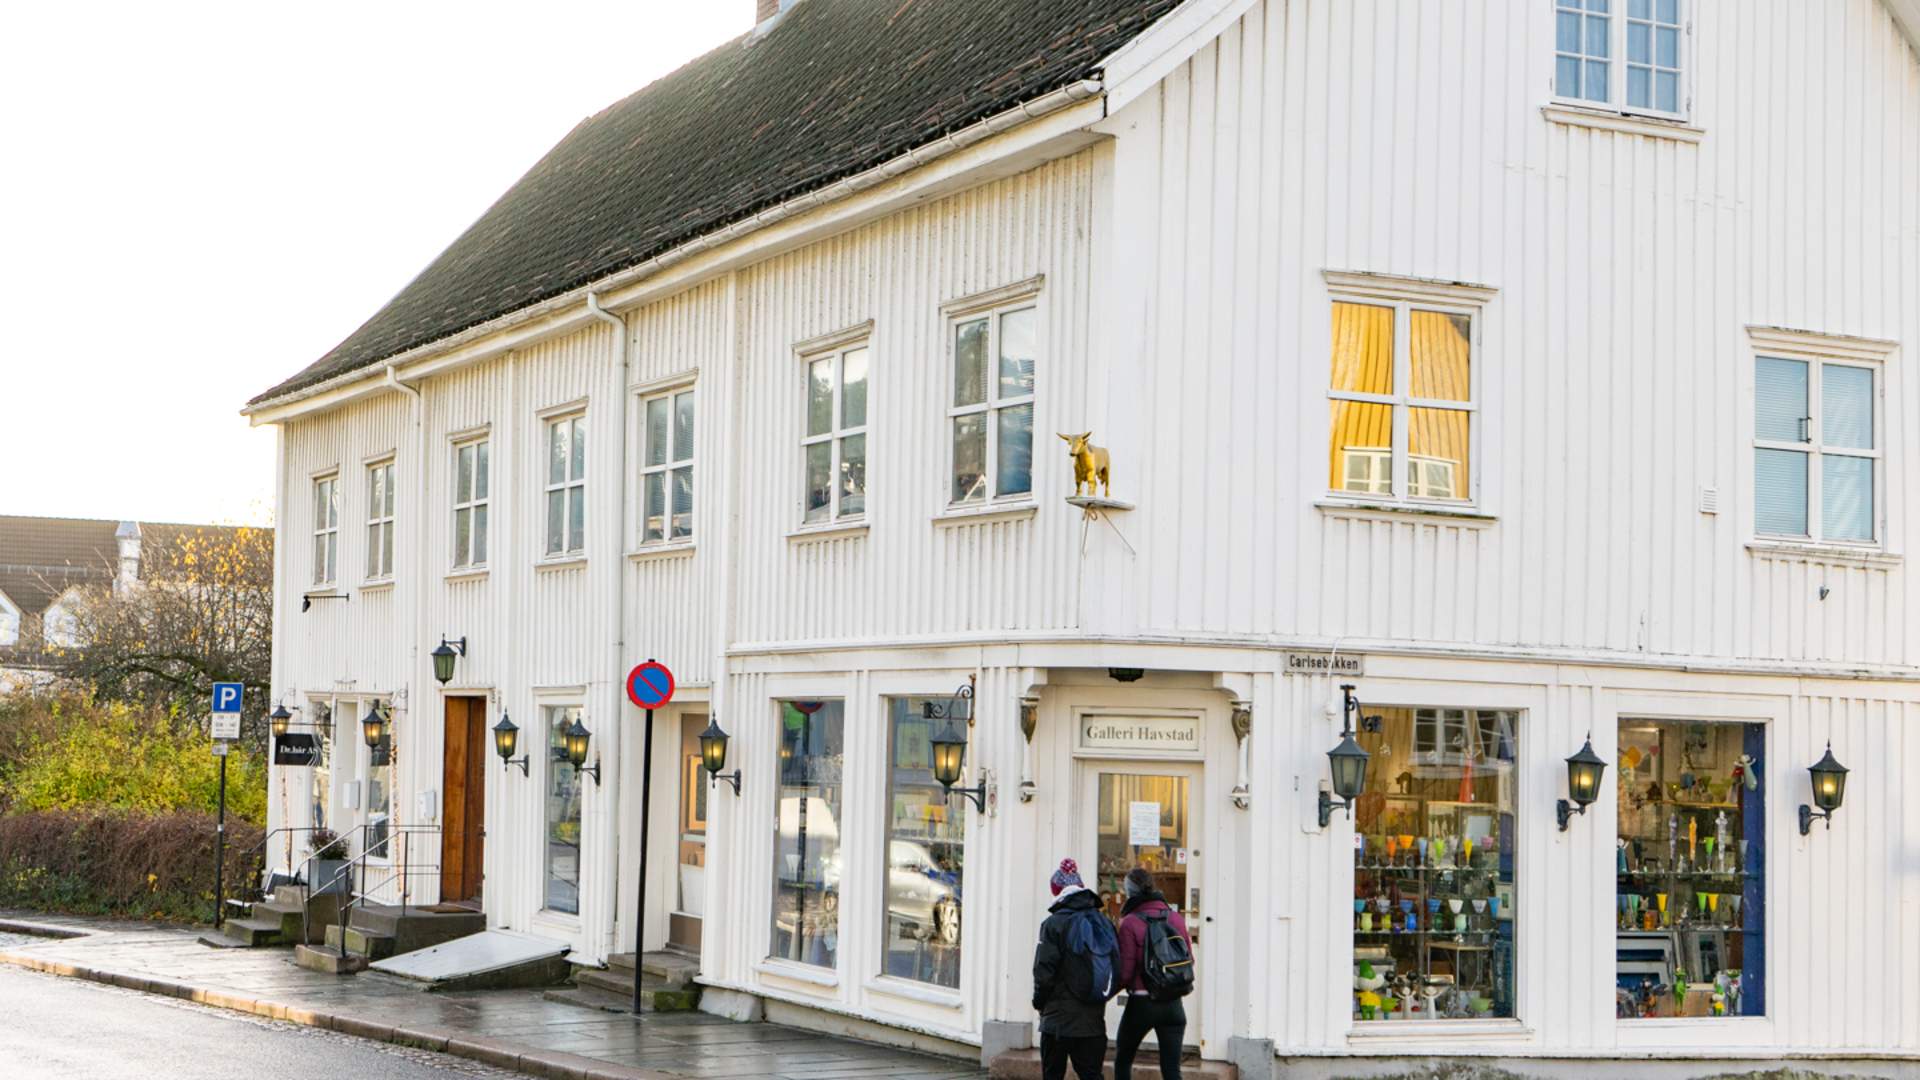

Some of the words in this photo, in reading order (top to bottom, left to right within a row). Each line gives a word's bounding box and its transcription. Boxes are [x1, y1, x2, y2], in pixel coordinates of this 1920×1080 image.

[220, 687, 236, 709] P
[1086, 725, 1134, 740] Galleri
[1138, 727, 1194, 741] Havstad
